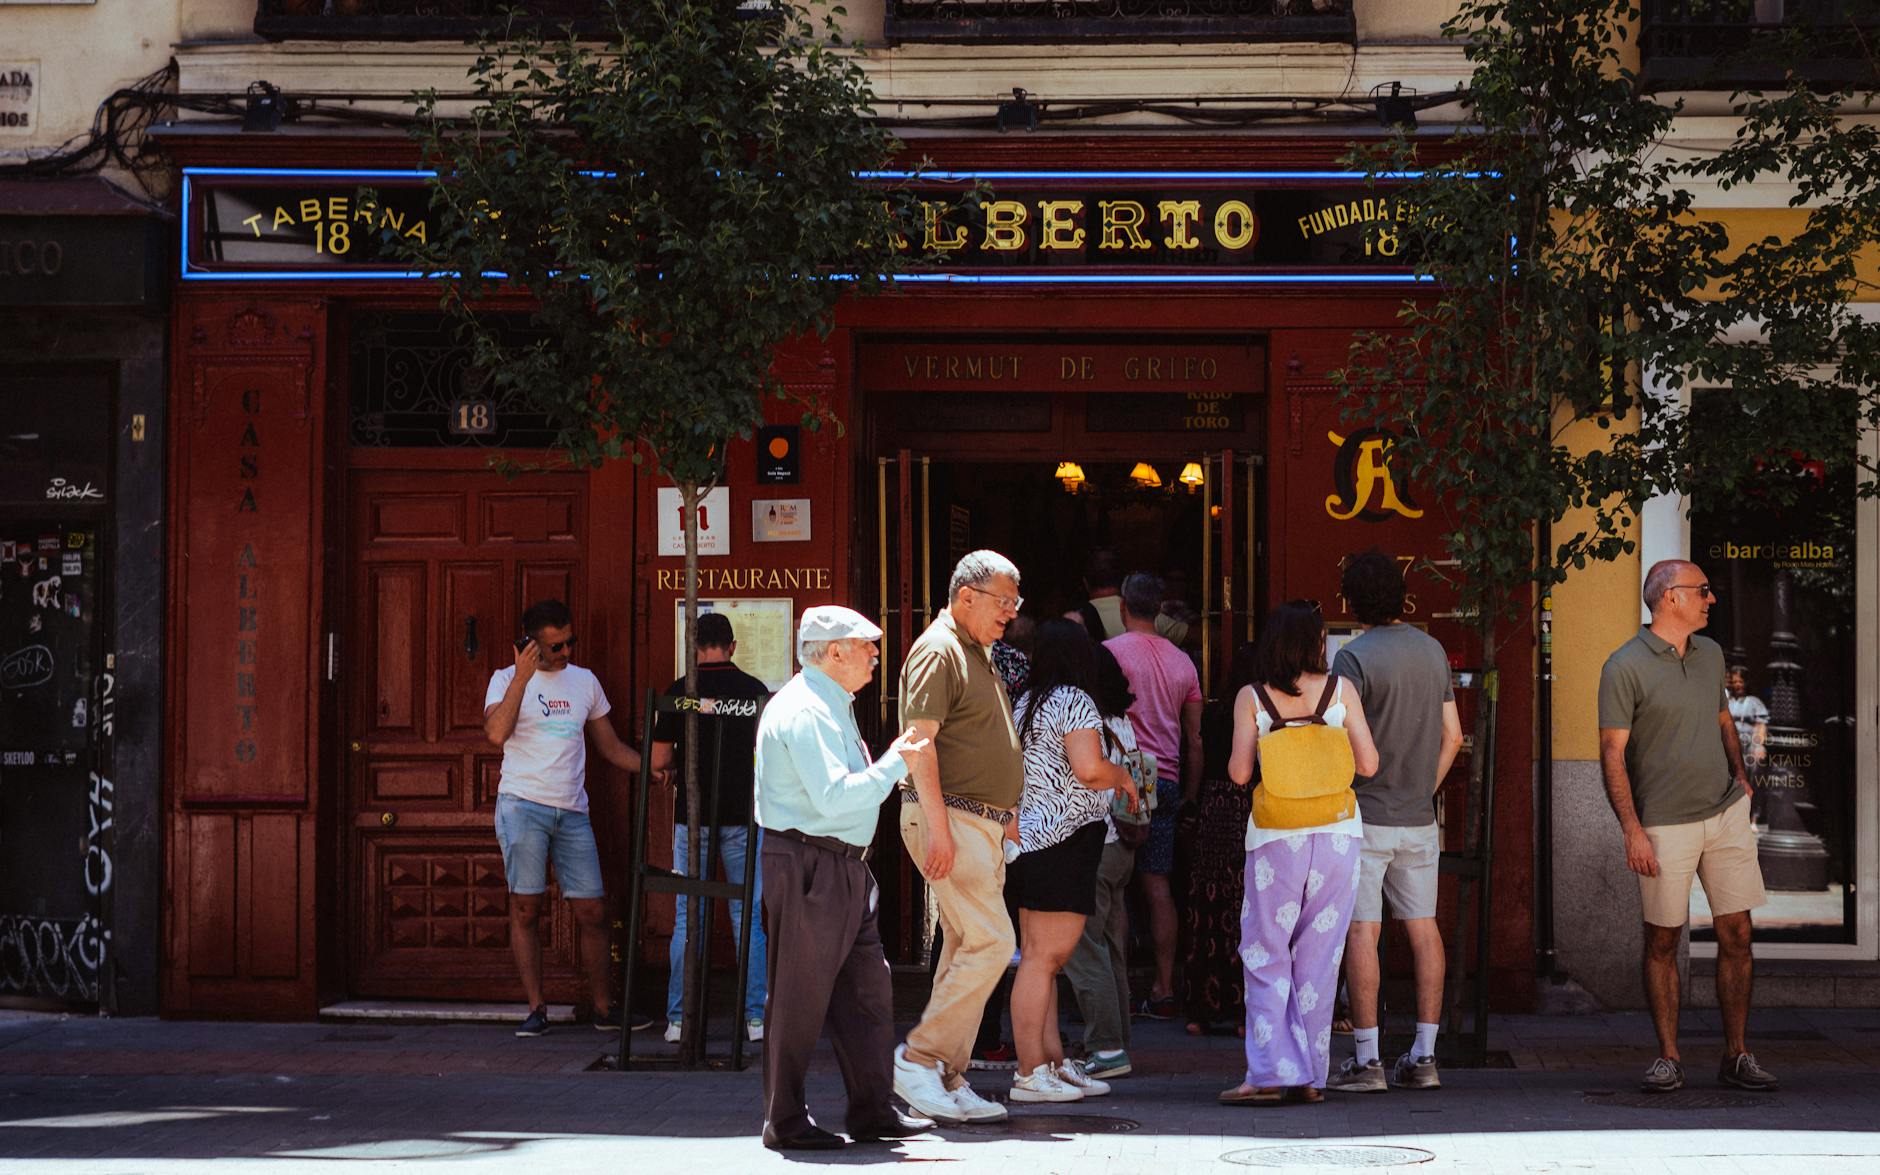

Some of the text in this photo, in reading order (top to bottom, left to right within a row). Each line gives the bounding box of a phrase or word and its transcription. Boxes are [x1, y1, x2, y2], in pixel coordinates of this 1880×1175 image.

[243, 196, 427, 246] TABERNA
[1298, 198, 1389, 240] FUNDADA
[314, 222, 350, 254] 18
[1365, 223, 1400, 256] 18
[905, 356, 1218, 381] VERMUT DE GRIFO
[459, 404, 489, 429] 18
[1197, 401, 1220, 414] DE
[1184, 416, 1230, 429] TORO
[234, 388, 261, 764] CASA ALBERTO
[657, 568, 832, 591] RESTAURANTE
[1739, 733, 1775, 746] OOD
[1744, 754, 1812, 767] OCKTAILS
[1755, 775, 1805, 788] WINES
